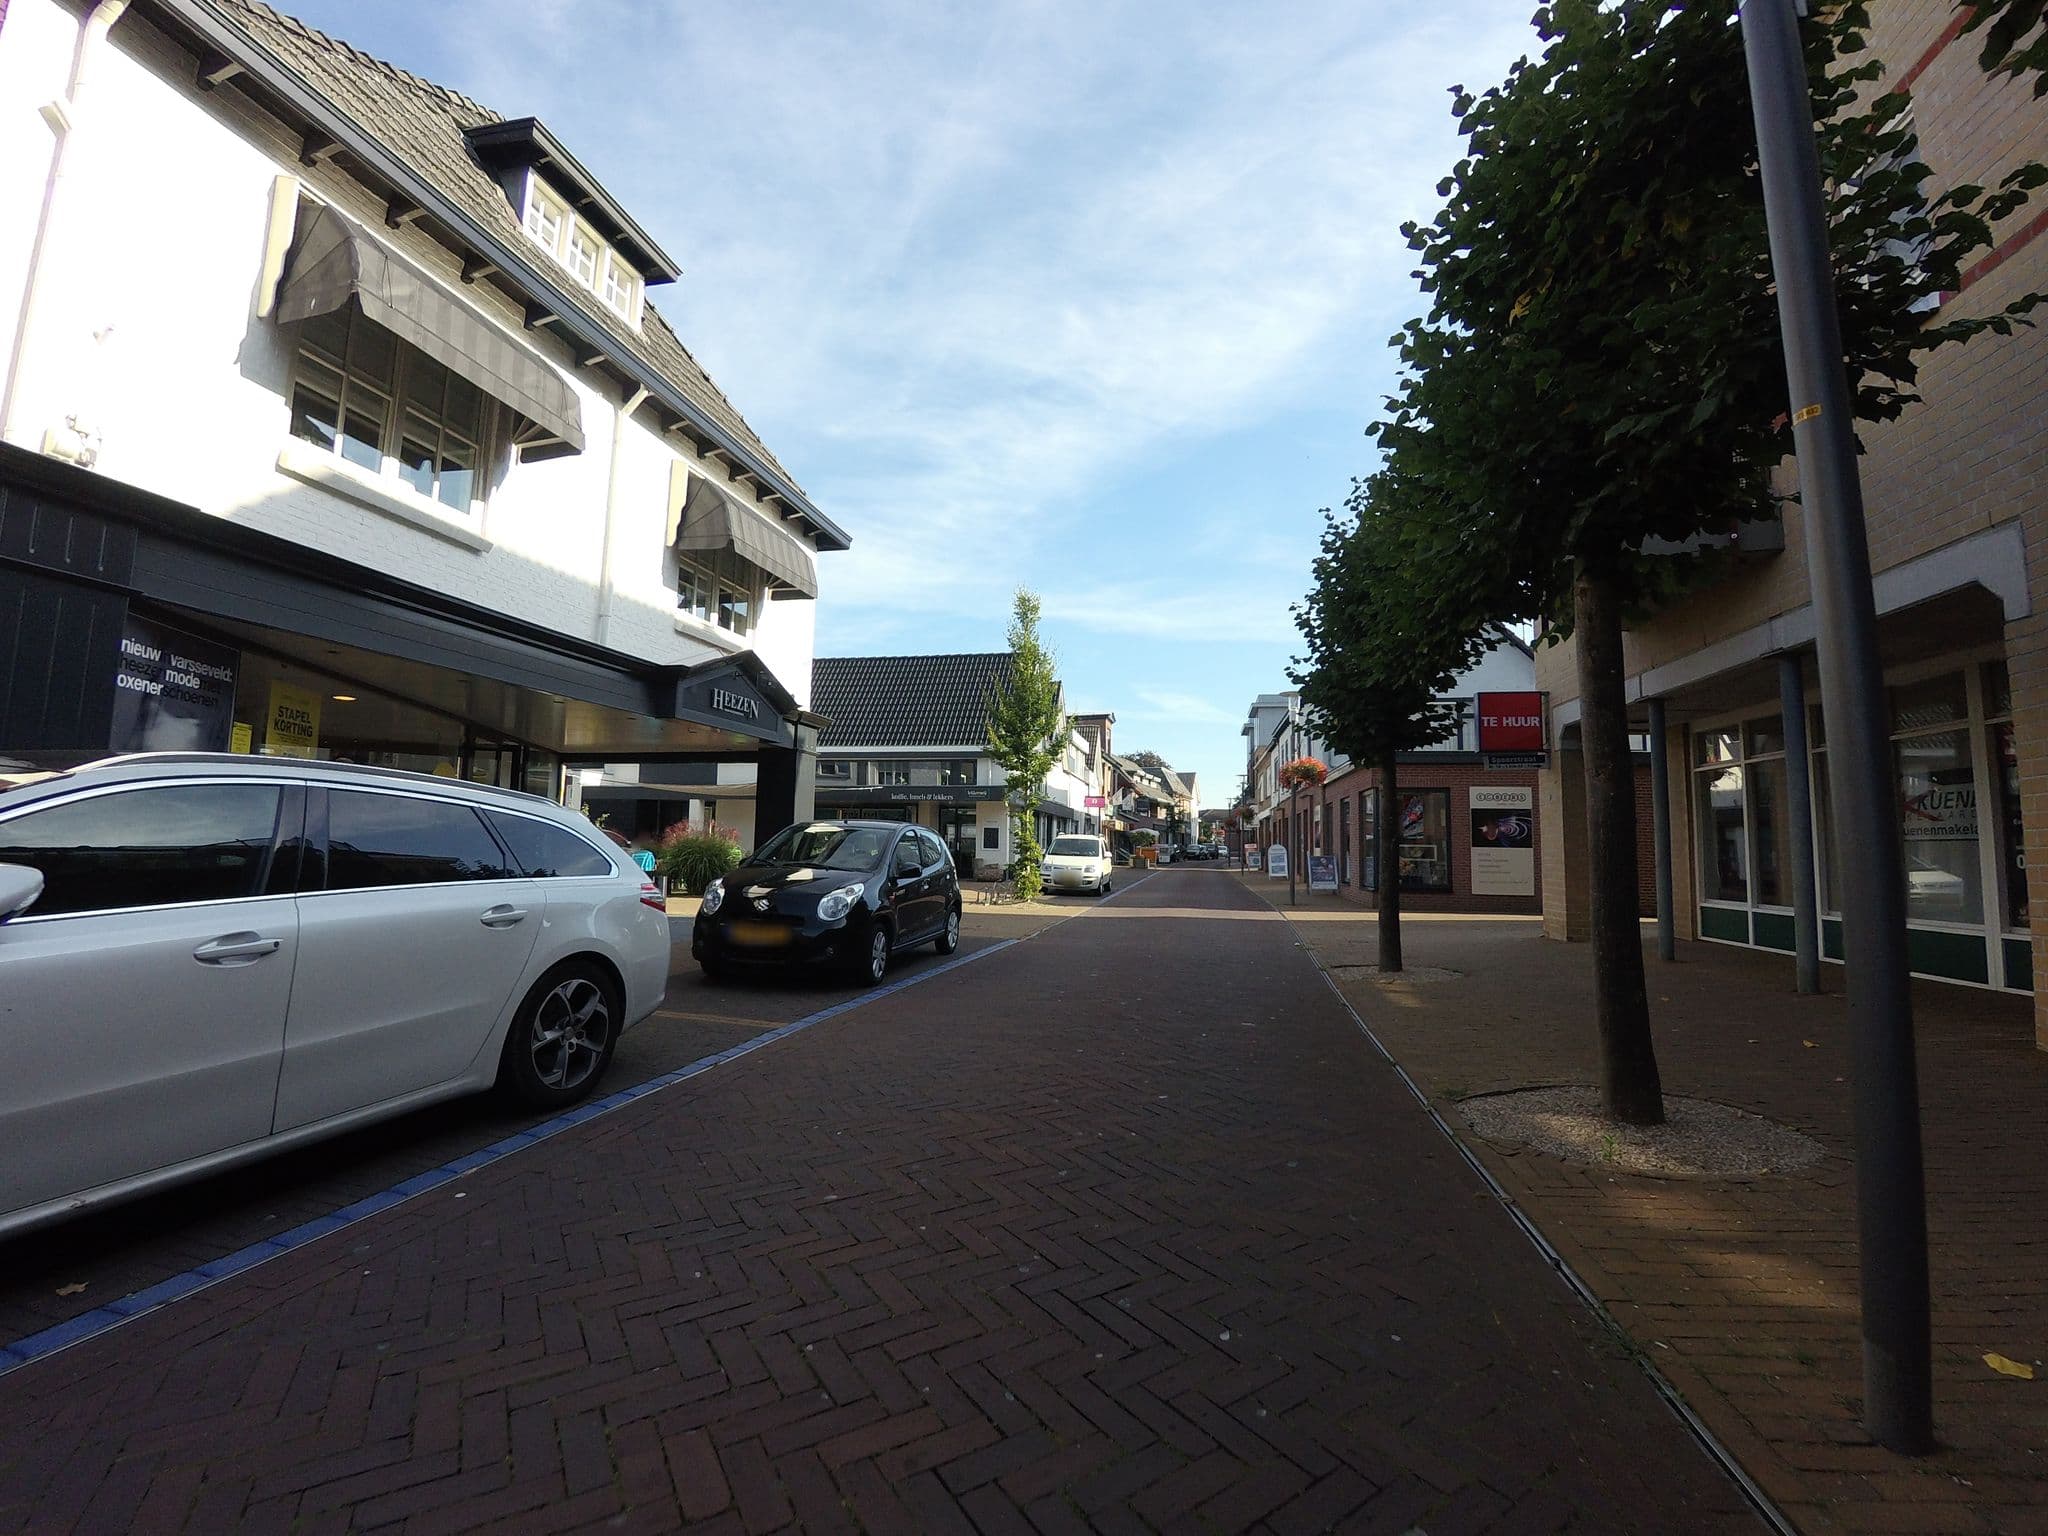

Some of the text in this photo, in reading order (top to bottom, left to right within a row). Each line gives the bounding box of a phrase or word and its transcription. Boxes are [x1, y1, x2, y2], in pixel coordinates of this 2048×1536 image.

[121, 638, 161, 661] nieuw
[170, 654, 232, 682] varsseveld:
[117, 674, 164, 695] oxener
[165, 669, 201, 689] mode
[712, 687, 760, 720] HEEZEN
[278, 706, 311, 723] STAPEL
[1481, 716, 1540, 727] TE HUUR
[274, 718, 313, 737] KORTING
